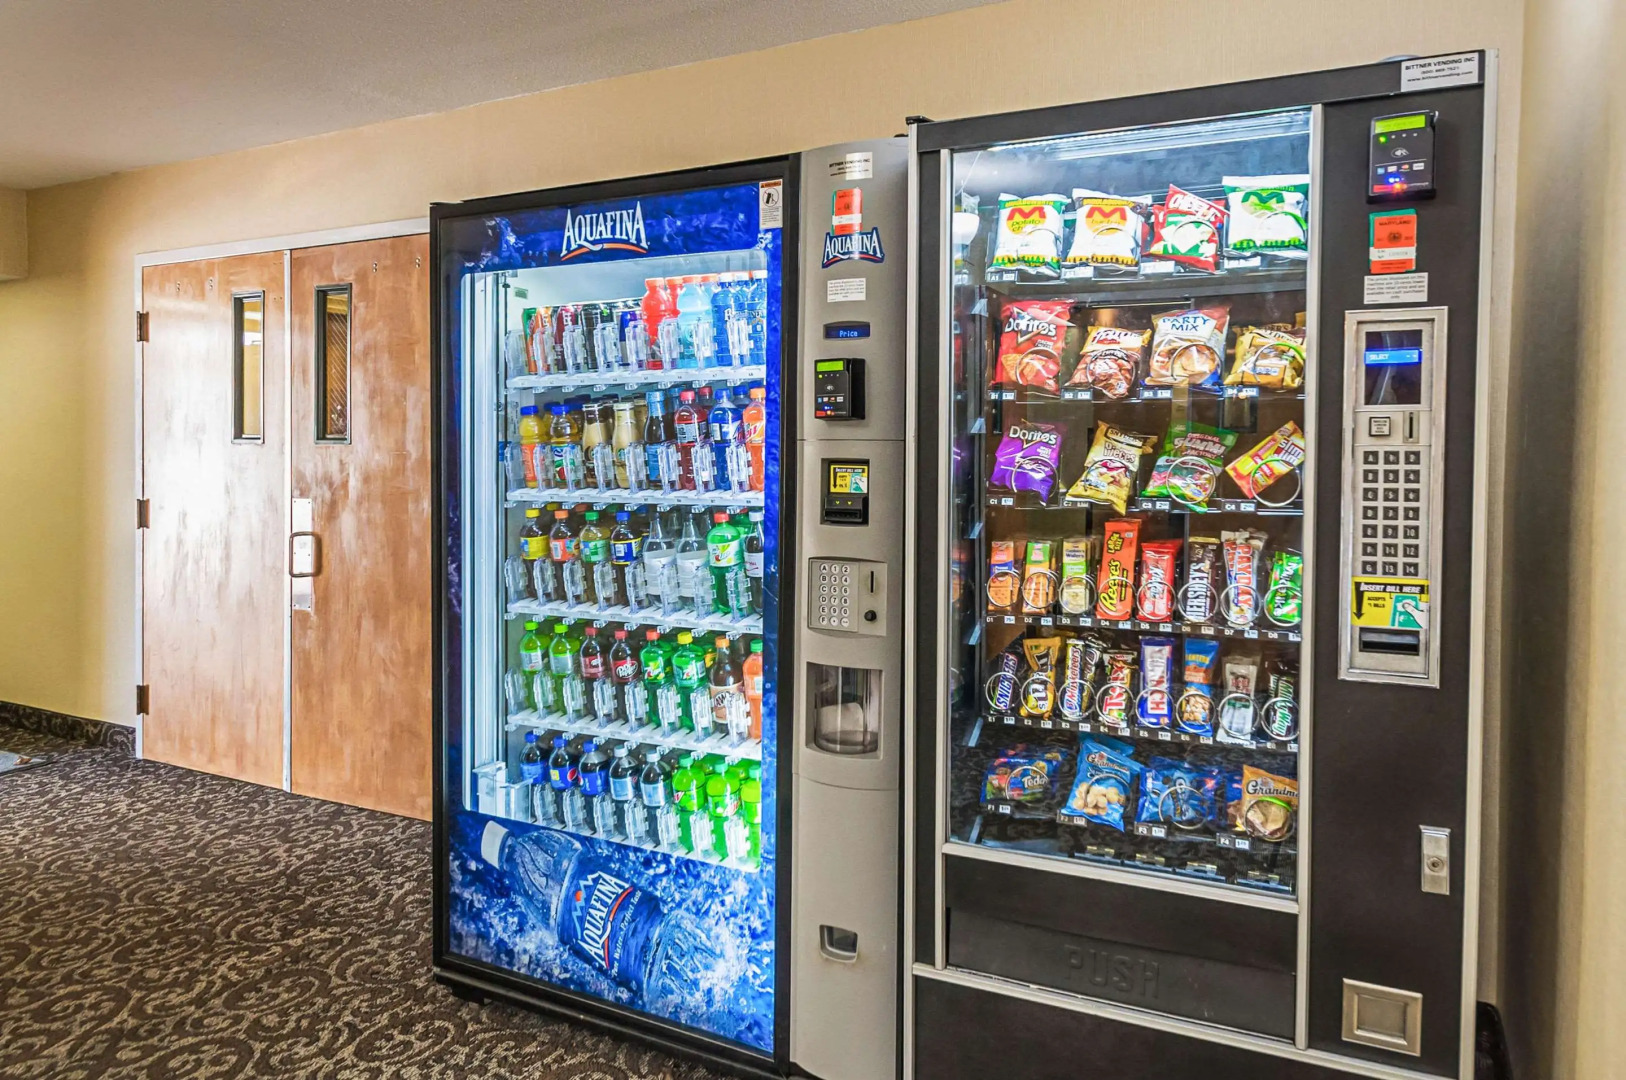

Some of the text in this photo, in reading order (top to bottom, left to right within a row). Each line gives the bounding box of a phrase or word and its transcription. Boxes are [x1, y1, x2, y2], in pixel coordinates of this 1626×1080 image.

[1405, 63, 1432, 71] BITTNER
[1433, 58, 1462, 67] VENDING
[560, 201, 648, 256] AQUAFINA
[1011, 218, 1041, 227] potato
[1005, 317, 1057, 337] Doritos
[1162, 316, 1210, 325] PARTY
[1170, 322, 1199, 332] MIX
[990, 392, 999, 400] B1
[1009, 426, 1058, 445] Doritos
[1368, 454, 1374, 462] A
[1409, 454, 1415, 462] 2
[1368, 491, 1373, 499] C
[1388, 491, 1394, 499] 5
[1388, 528, 1393, 536] 9
[1406, 528, 1415, 537] 10
[1385, 546, 1395, 554] 11
[1406, 547, 1415, 555] 12
[1236, 544, 1253, 608] PAYDAY
[1385, 565, 1394, 573] 13
[1406, 565, 1415, 574] 14
[1100, 558, 1121, 612] Reese's
[1186, 562, 1210, 620] HERSHEY'S
[1360, 582, 1422, 594] INSERT BILL HERE
[1061, 617, 1071, 625] D3
[996, 652, 1018, 709] SNICKERS
[1066, 647, 1082, 703] Musketeers
[1271, 706, 1292, 736] Way
[579, 870, 631, 969] AQUAFINA
[613, 935, 623, 959] Water
[620, 904, 635, 930] Perfect
[633, 890, 642, 905] Taste
[1063, 944, 1160, 1000] PUSH
